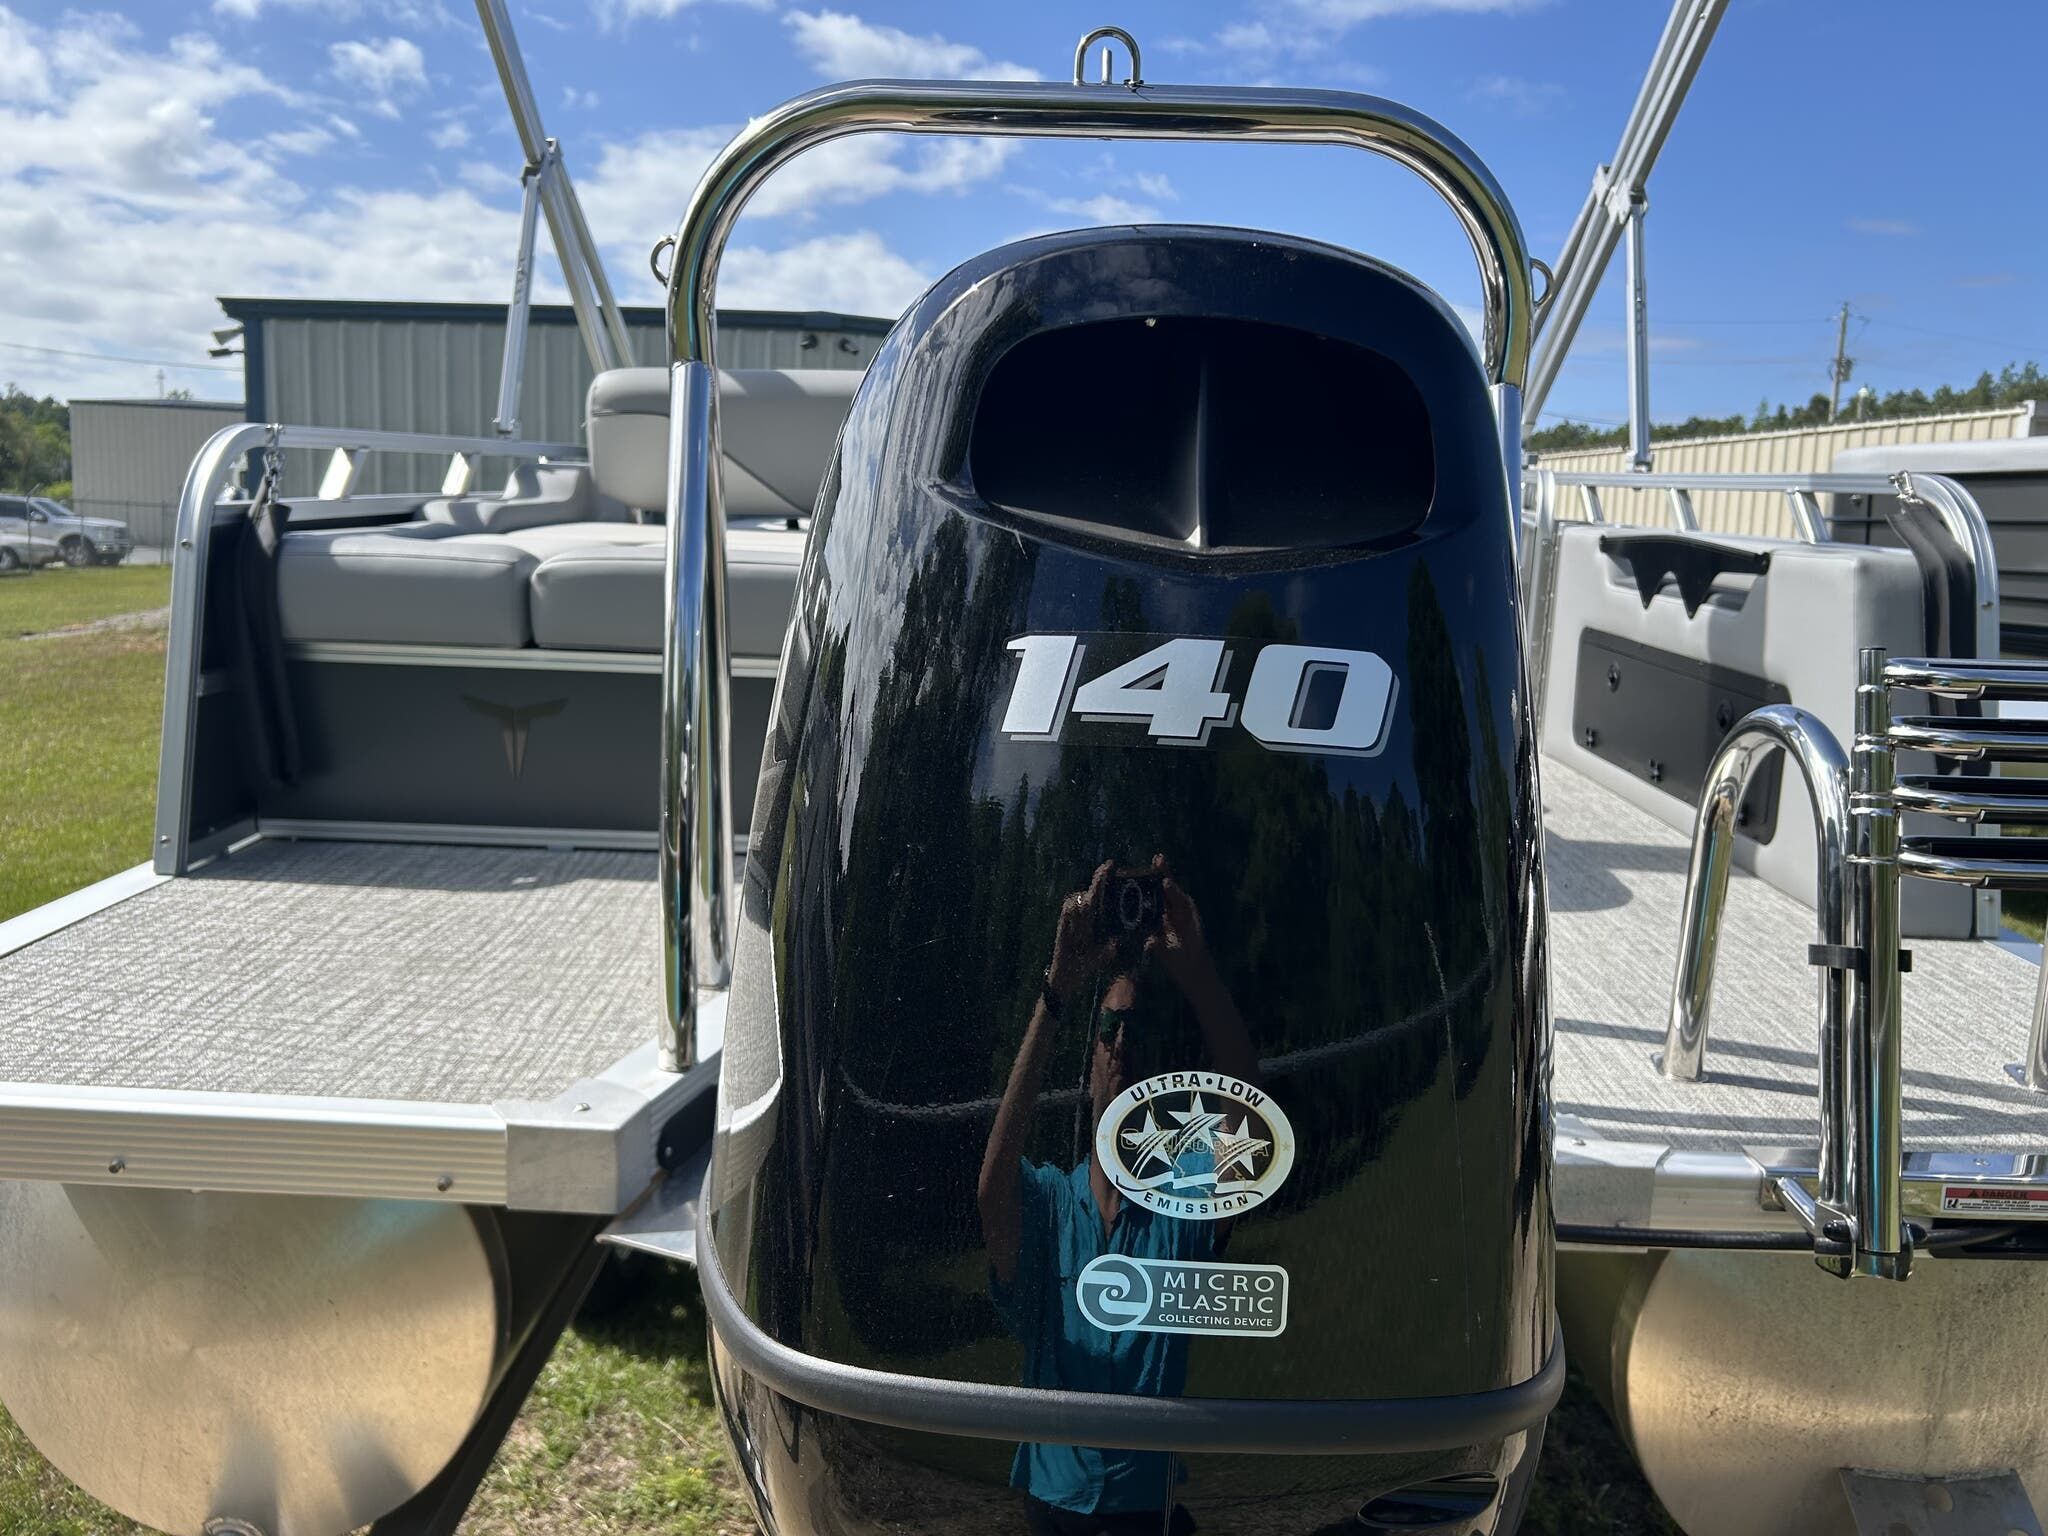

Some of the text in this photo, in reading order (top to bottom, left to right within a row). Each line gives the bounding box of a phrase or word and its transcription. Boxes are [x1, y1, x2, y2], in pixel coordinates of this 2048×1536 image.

[1001, 635, 1400, 758] 140
[1143, 1191, 1249, 1214] EMISSION
[1163, 1271, 1275, 1293] MICRO
[1159, 1292, 1273, 1314] PLASTIC
[1158, 1313, 1273, 1327] COLLECTING DEVICE
